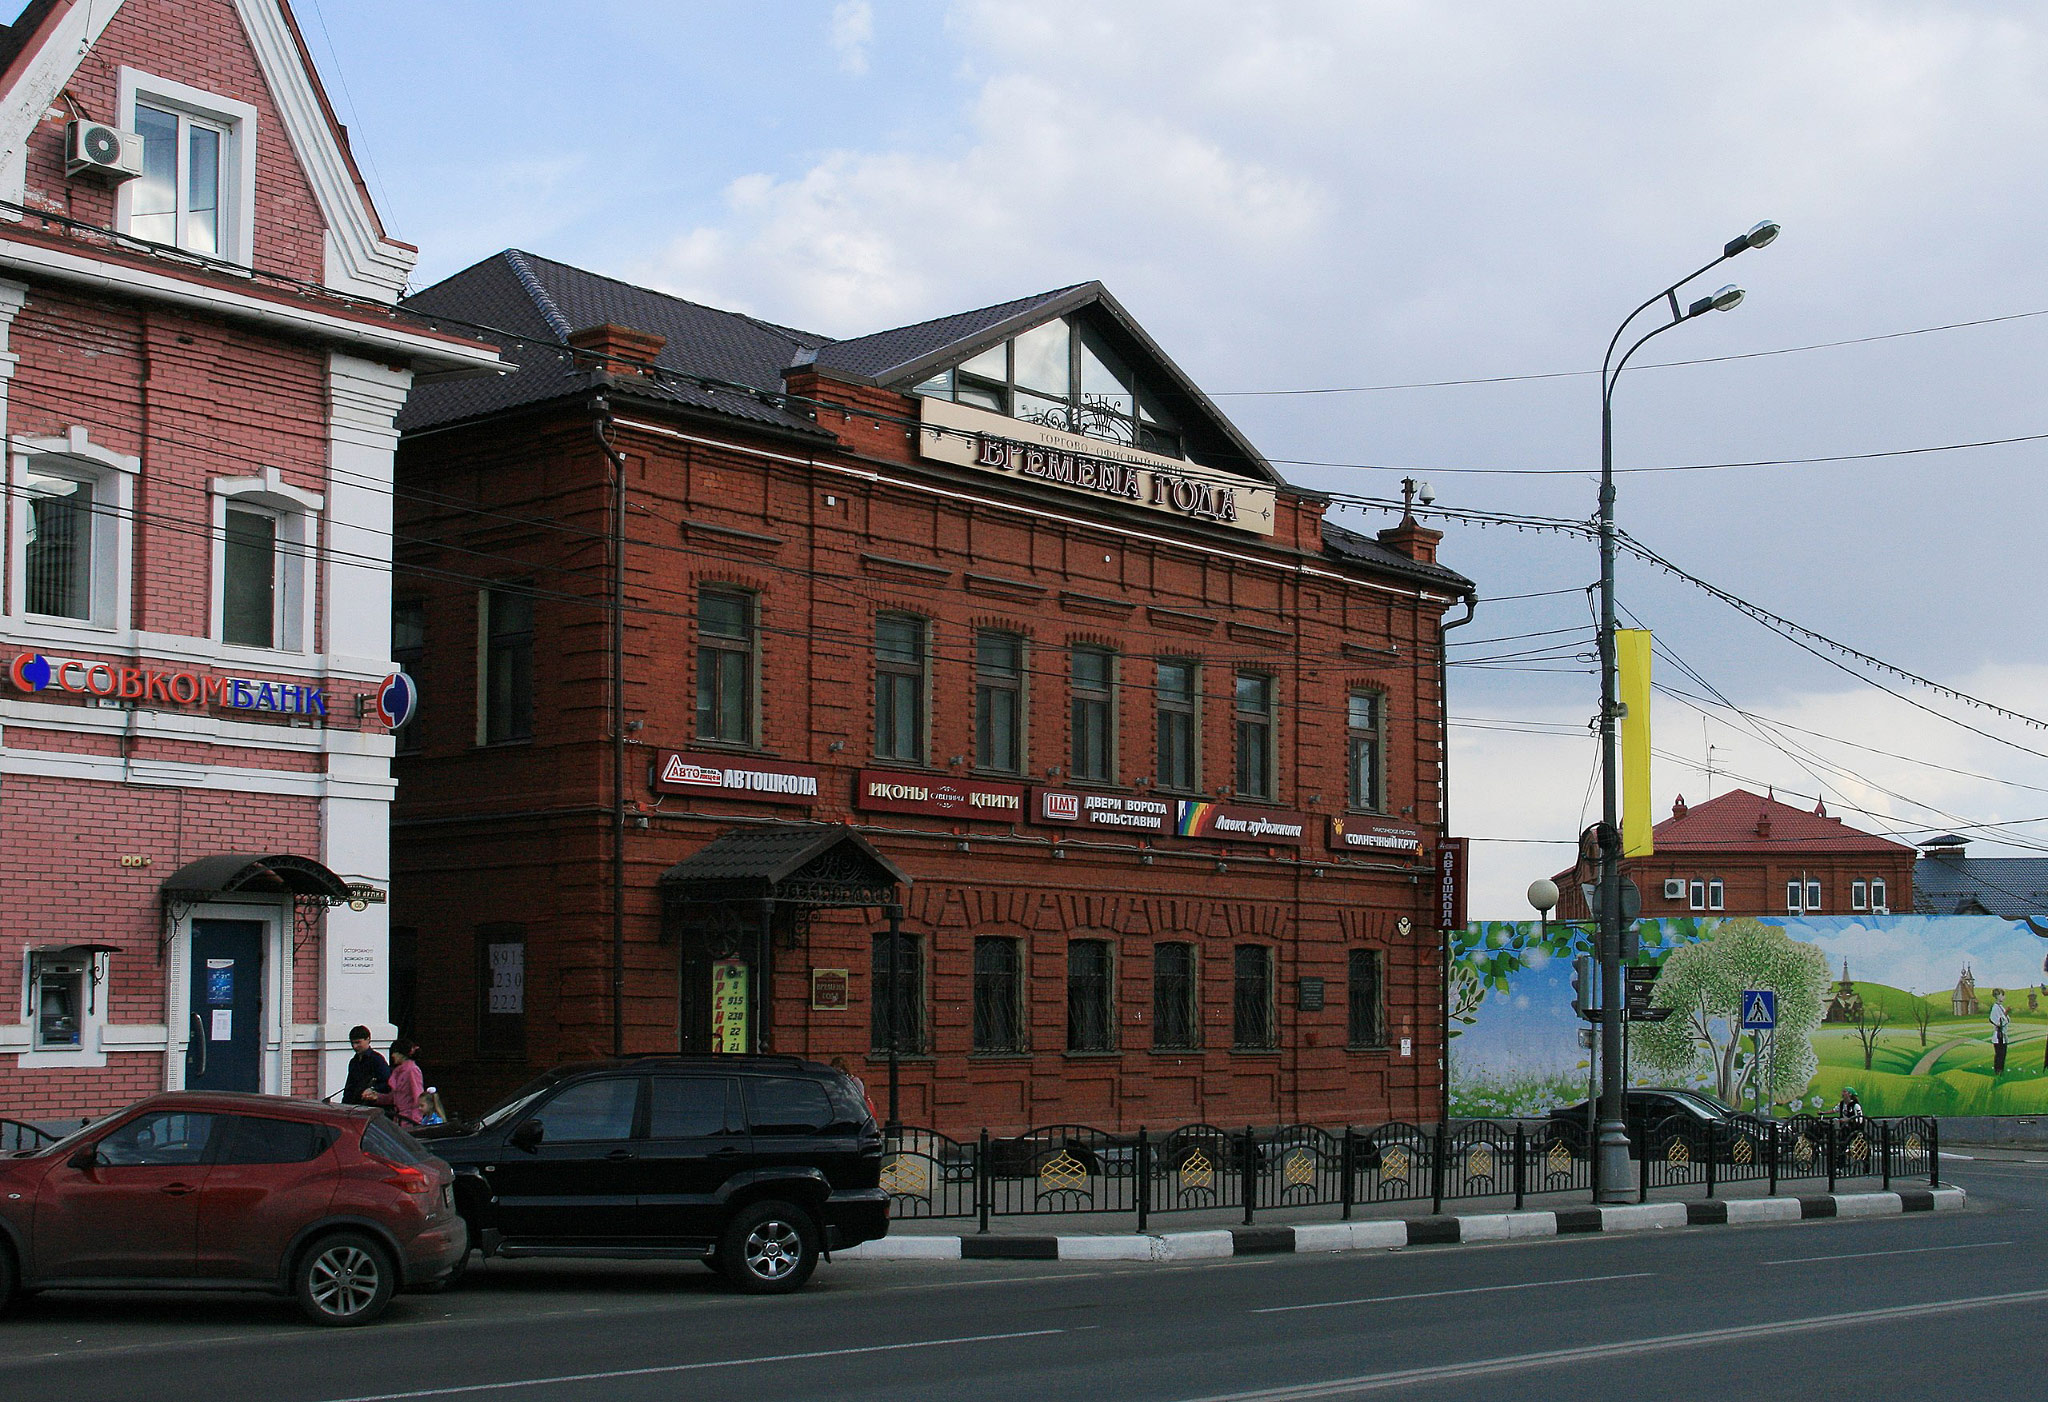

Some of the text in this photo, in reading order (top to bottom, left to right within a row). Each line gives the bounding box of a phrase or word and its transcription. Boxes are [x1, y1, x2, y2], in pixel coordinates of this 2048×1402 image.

[1040, 432, 1088, 452] ТОРГОВО
[979, 436, 1239, 521] ВРЕМЕНА ГОДА
[57, 661, 329, 716] СОВКОМБАНК
[723, 769, 818, 796] АВТОШКОЛА
[868, 782, 929, 801] ИКОНЫ
[969, 792, 1019, 809] КНИГИ
[1084, 796, 1168, 815] ДВЕРИ ВОРОТА
[1090, 811, 1161, 828] РОЛЬСТАВНИ
[1215, 814, 1302, 837] Лавка художника
[1345, 833, 1419, 850] СОЛНЕЧНЫЙ КРУГ
[1442, 851, 1454, 927] АВТОШКОЛА
[496, 972, 522, 988] 230
[492, 994, 517, 1010] 222
[727, 996, 744, 1005] 915
[729, 1027, 741, 1036] 22
[729, 1042, 740, 1052] 21
